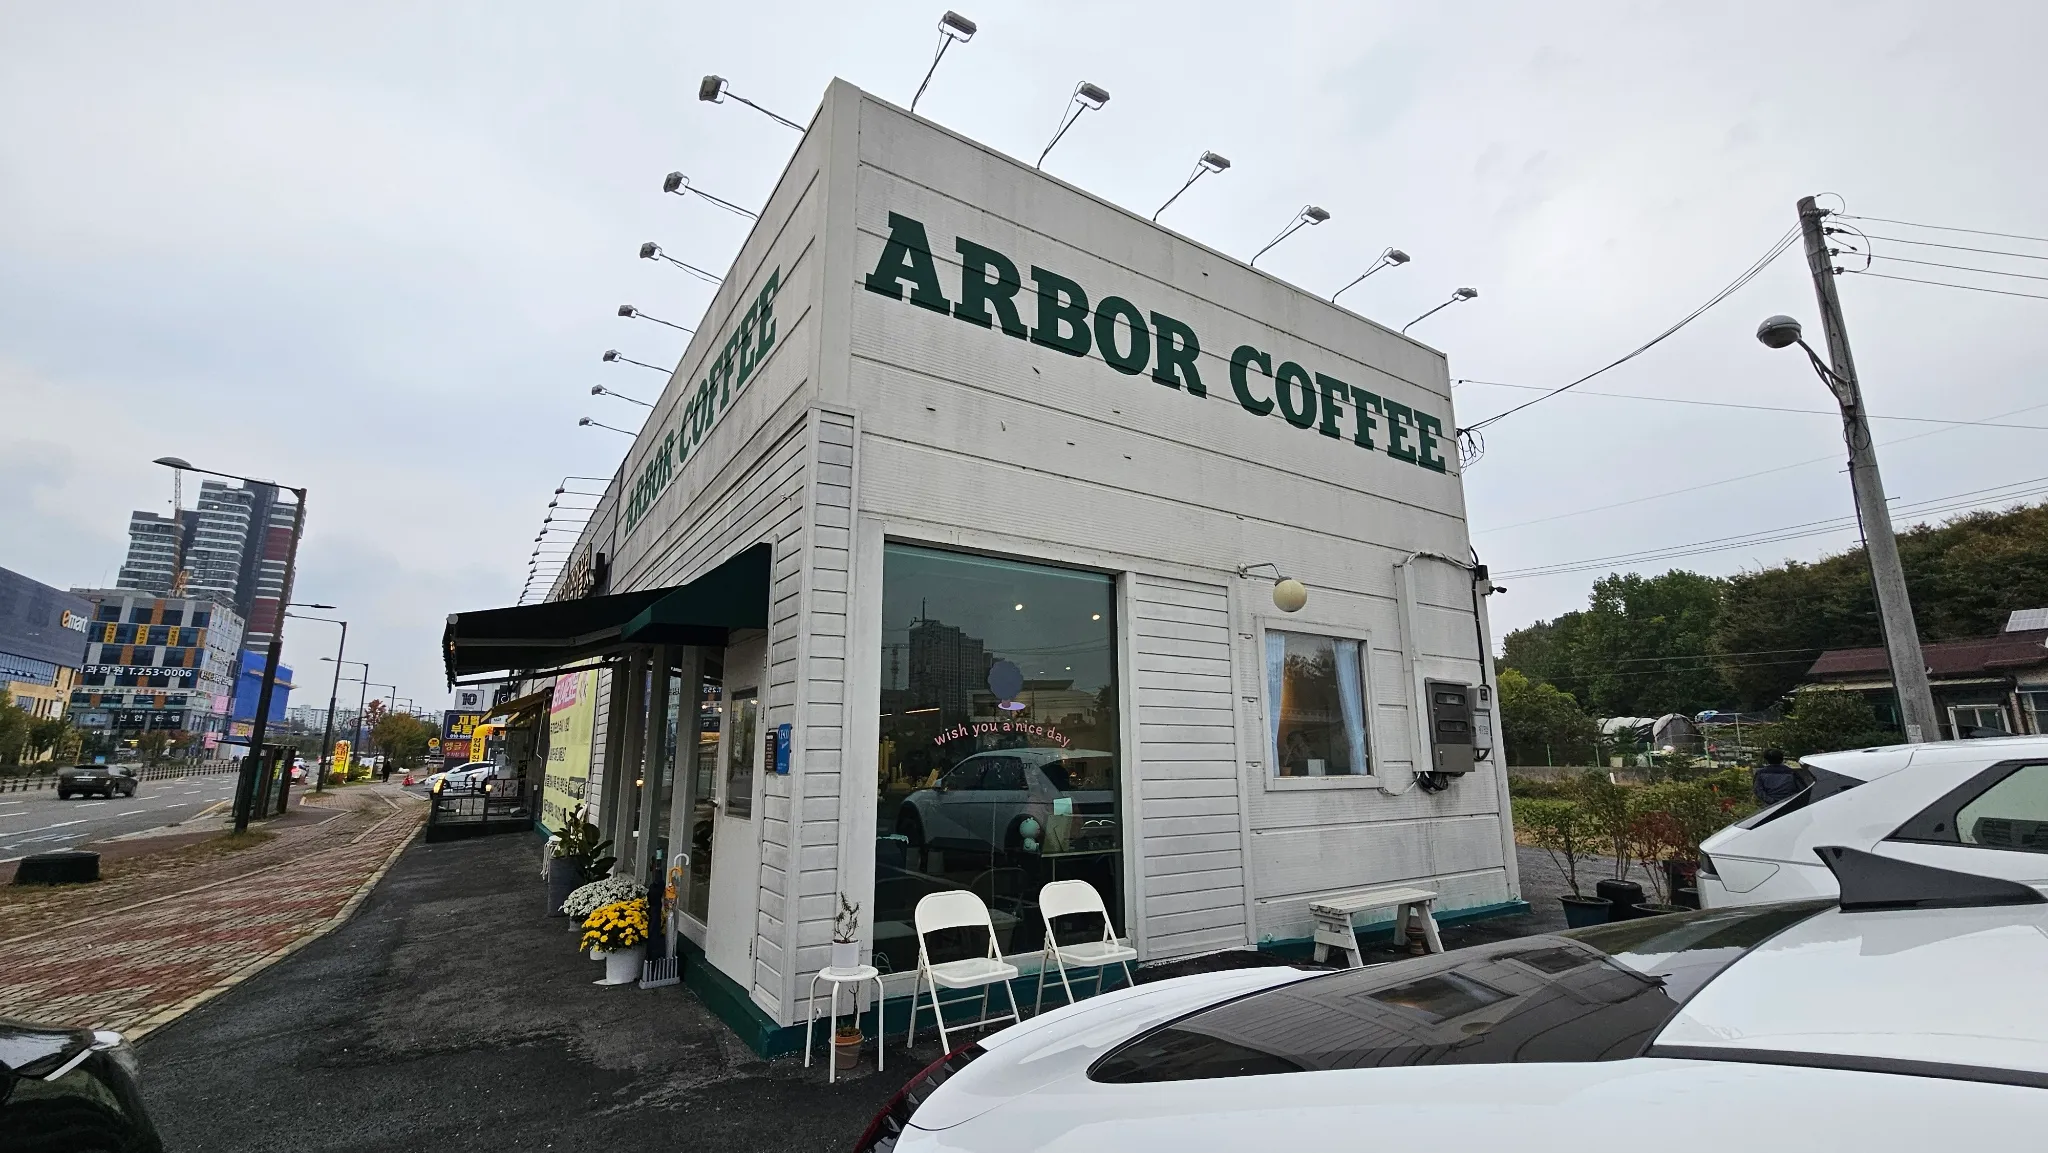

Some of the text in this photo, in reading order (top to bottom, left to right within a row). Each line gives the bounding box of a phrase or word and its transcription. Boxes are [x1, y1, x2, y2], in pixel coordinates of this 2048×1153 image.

[865, 211, 1447, 474] ARBOR COFFEE
[625, 264, 780, 538] ARBOR COFFEE
[61, 609, 88, 633] emart
[129, 667, 192, 677] T.253-0006
[934, 720, 1070, 748] wish you a nice day
